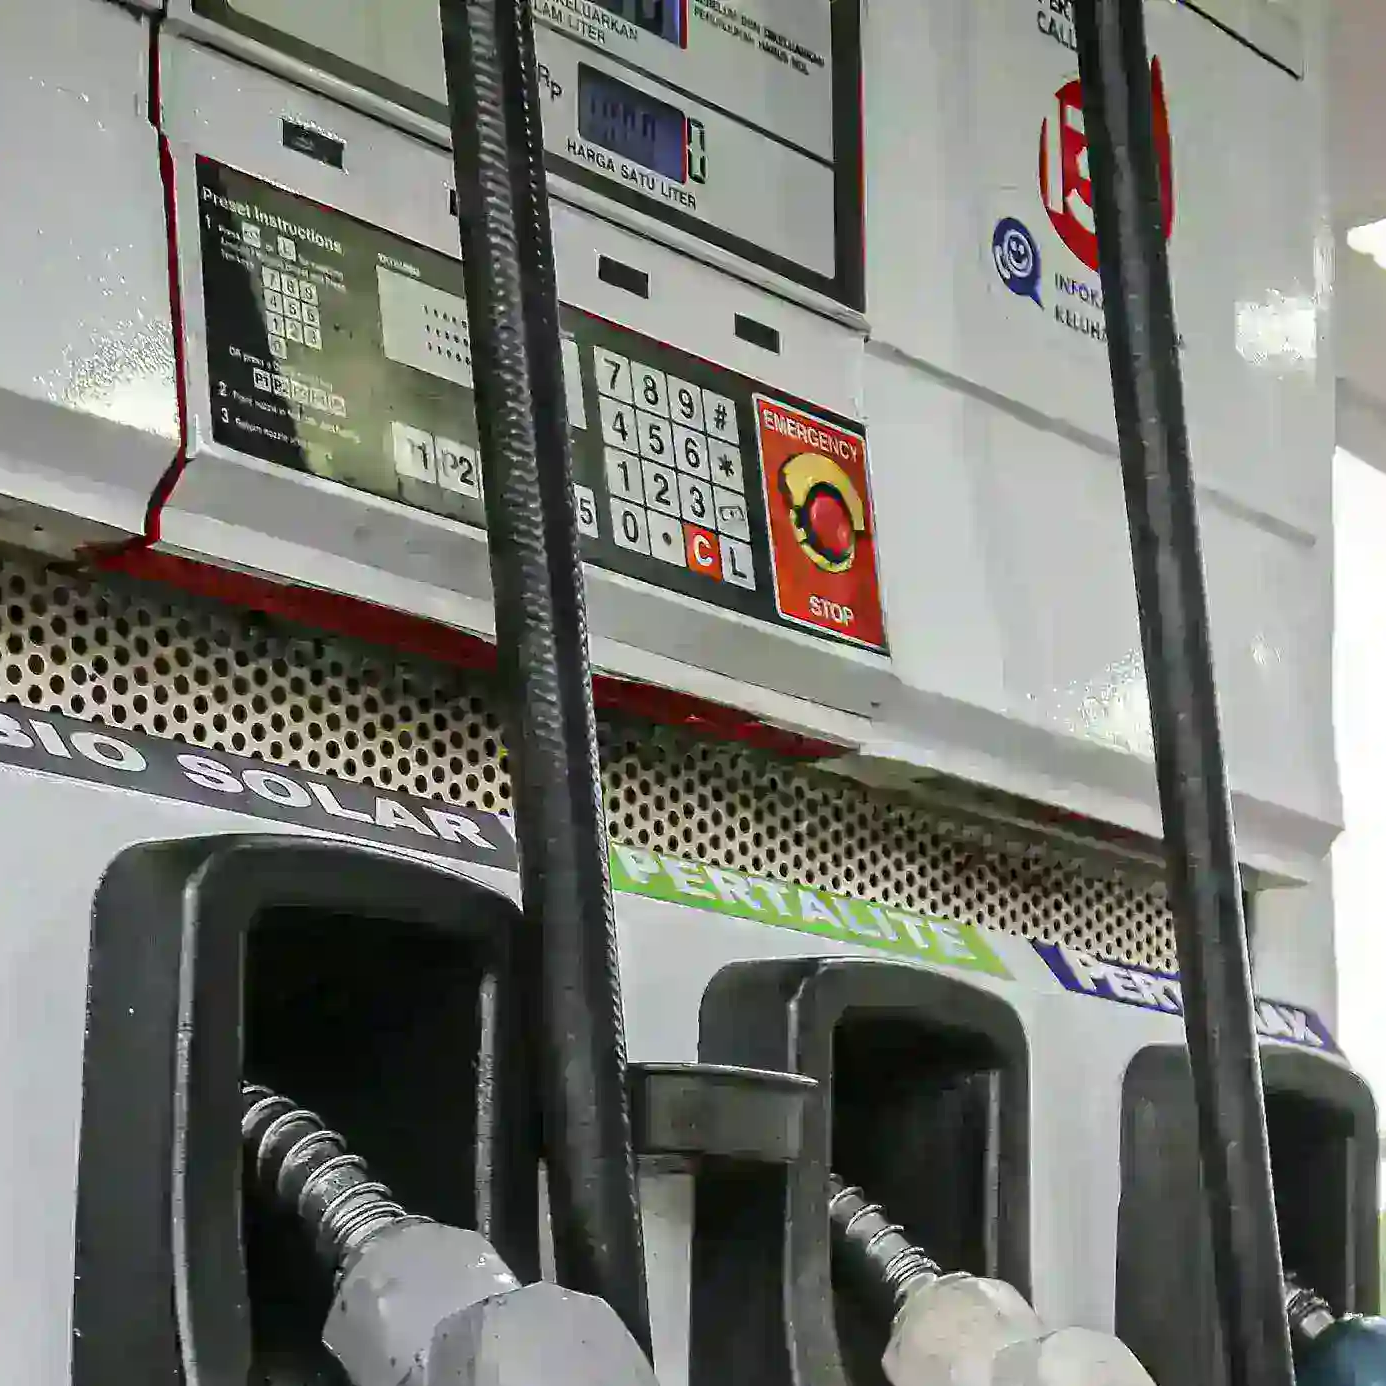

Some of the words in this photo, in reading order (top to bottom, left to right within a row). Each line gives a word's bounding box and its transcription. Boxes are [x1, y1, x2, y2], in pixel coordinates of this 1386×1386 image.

[566, 138, 615, 173] HARGA
[621, 162, 656, 191] SATU
[661, 181, 697, 211] LITER
[202, 185, 250, 220] Preset
[253, 204, 344, 257] Instructions
[603, 357, 621, 390] 7
[643, 374, 659, 406] 8
[678, 388, 694, 419] 9
[612, 411, 628, 442] 4
[648, 424, 665, 455] 5
[684, 437, 700, 469] 6
[763, 409, 858, 462] EMERGENCY
[617, 461, 630, 492] 1
[653, 472, 671, 506] 2
[689, 486, 706, 518] 3
[621, 509, 639, 544] 0
[693, 534, 713, 567] C
[729, 545, 748, 579] L
[809, 594, 855, 627] STOP
[177, 752, 498, 851] SOLAR
[613, 844, 977, 961] PERTALITE
